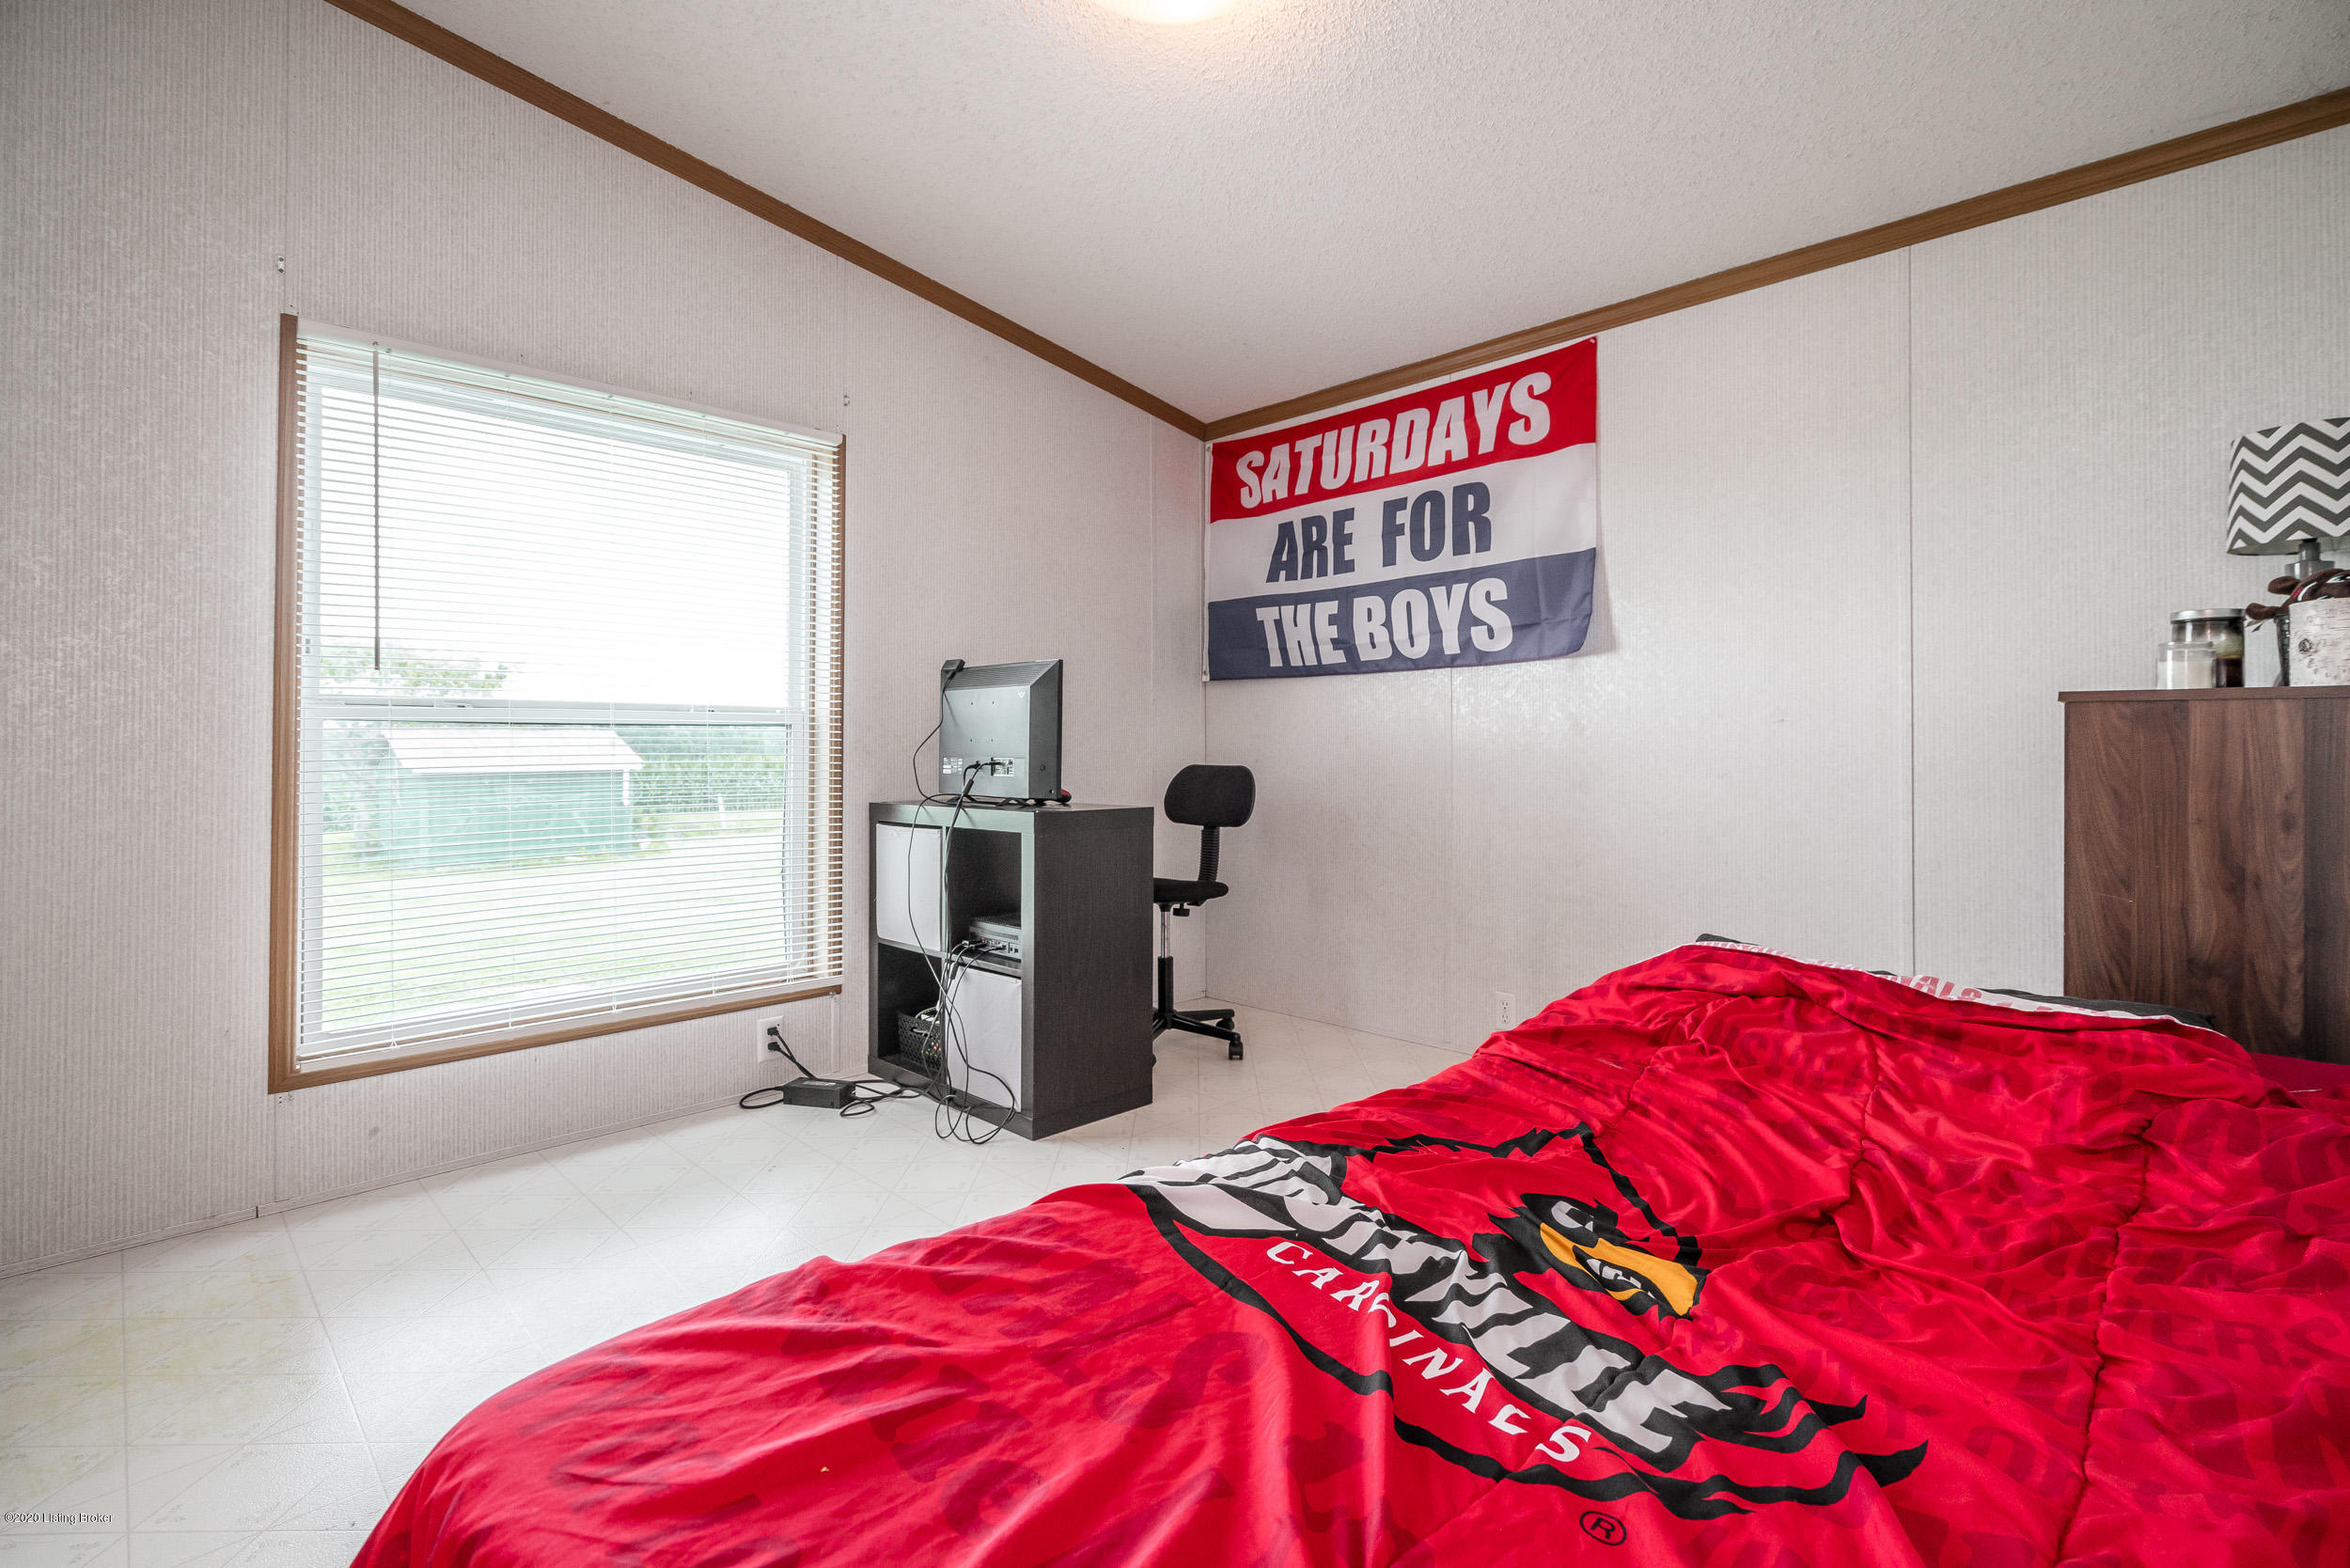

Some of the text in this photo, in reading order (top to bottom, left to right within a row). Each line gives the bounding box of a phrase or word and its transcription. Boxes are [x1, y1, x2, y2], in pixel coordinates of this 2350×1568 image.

[1236, 371, 1551, 509] SATURDAYS
[1266, 481, 1492, 583] ARE FOR
[1256, 578, 1513, 667] THE BOYS
